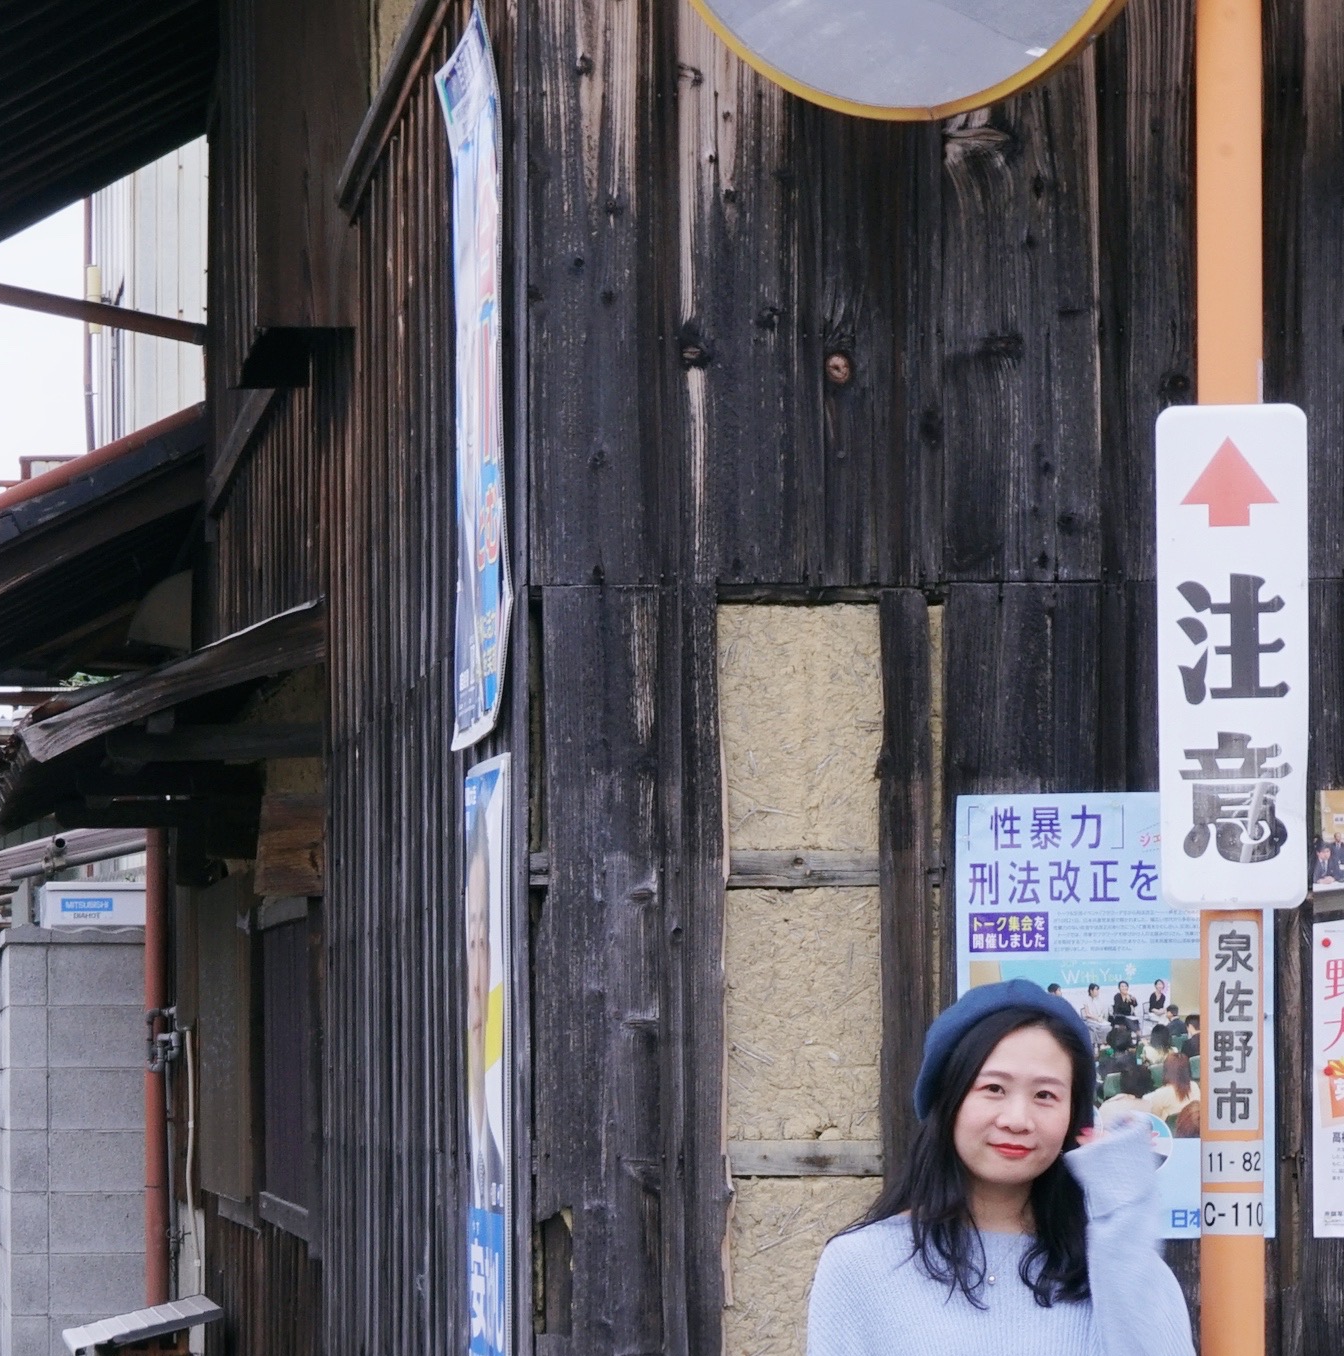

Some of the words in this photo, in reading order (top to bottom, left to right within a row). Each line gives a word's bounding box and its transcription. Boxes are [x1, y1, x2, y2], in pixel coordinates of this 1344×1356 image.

[1176, 573, 1293, 864] 注意
[969, 859, 1159, 906] 刑法改正を
[972, 915, 1046, 932] トーク集会を
[972, 932, 1046, 950] 開催しました
[1213, 929, 1254, 1124] 泉佐野市
[1204, 1202, 1264, 1229] C-110
